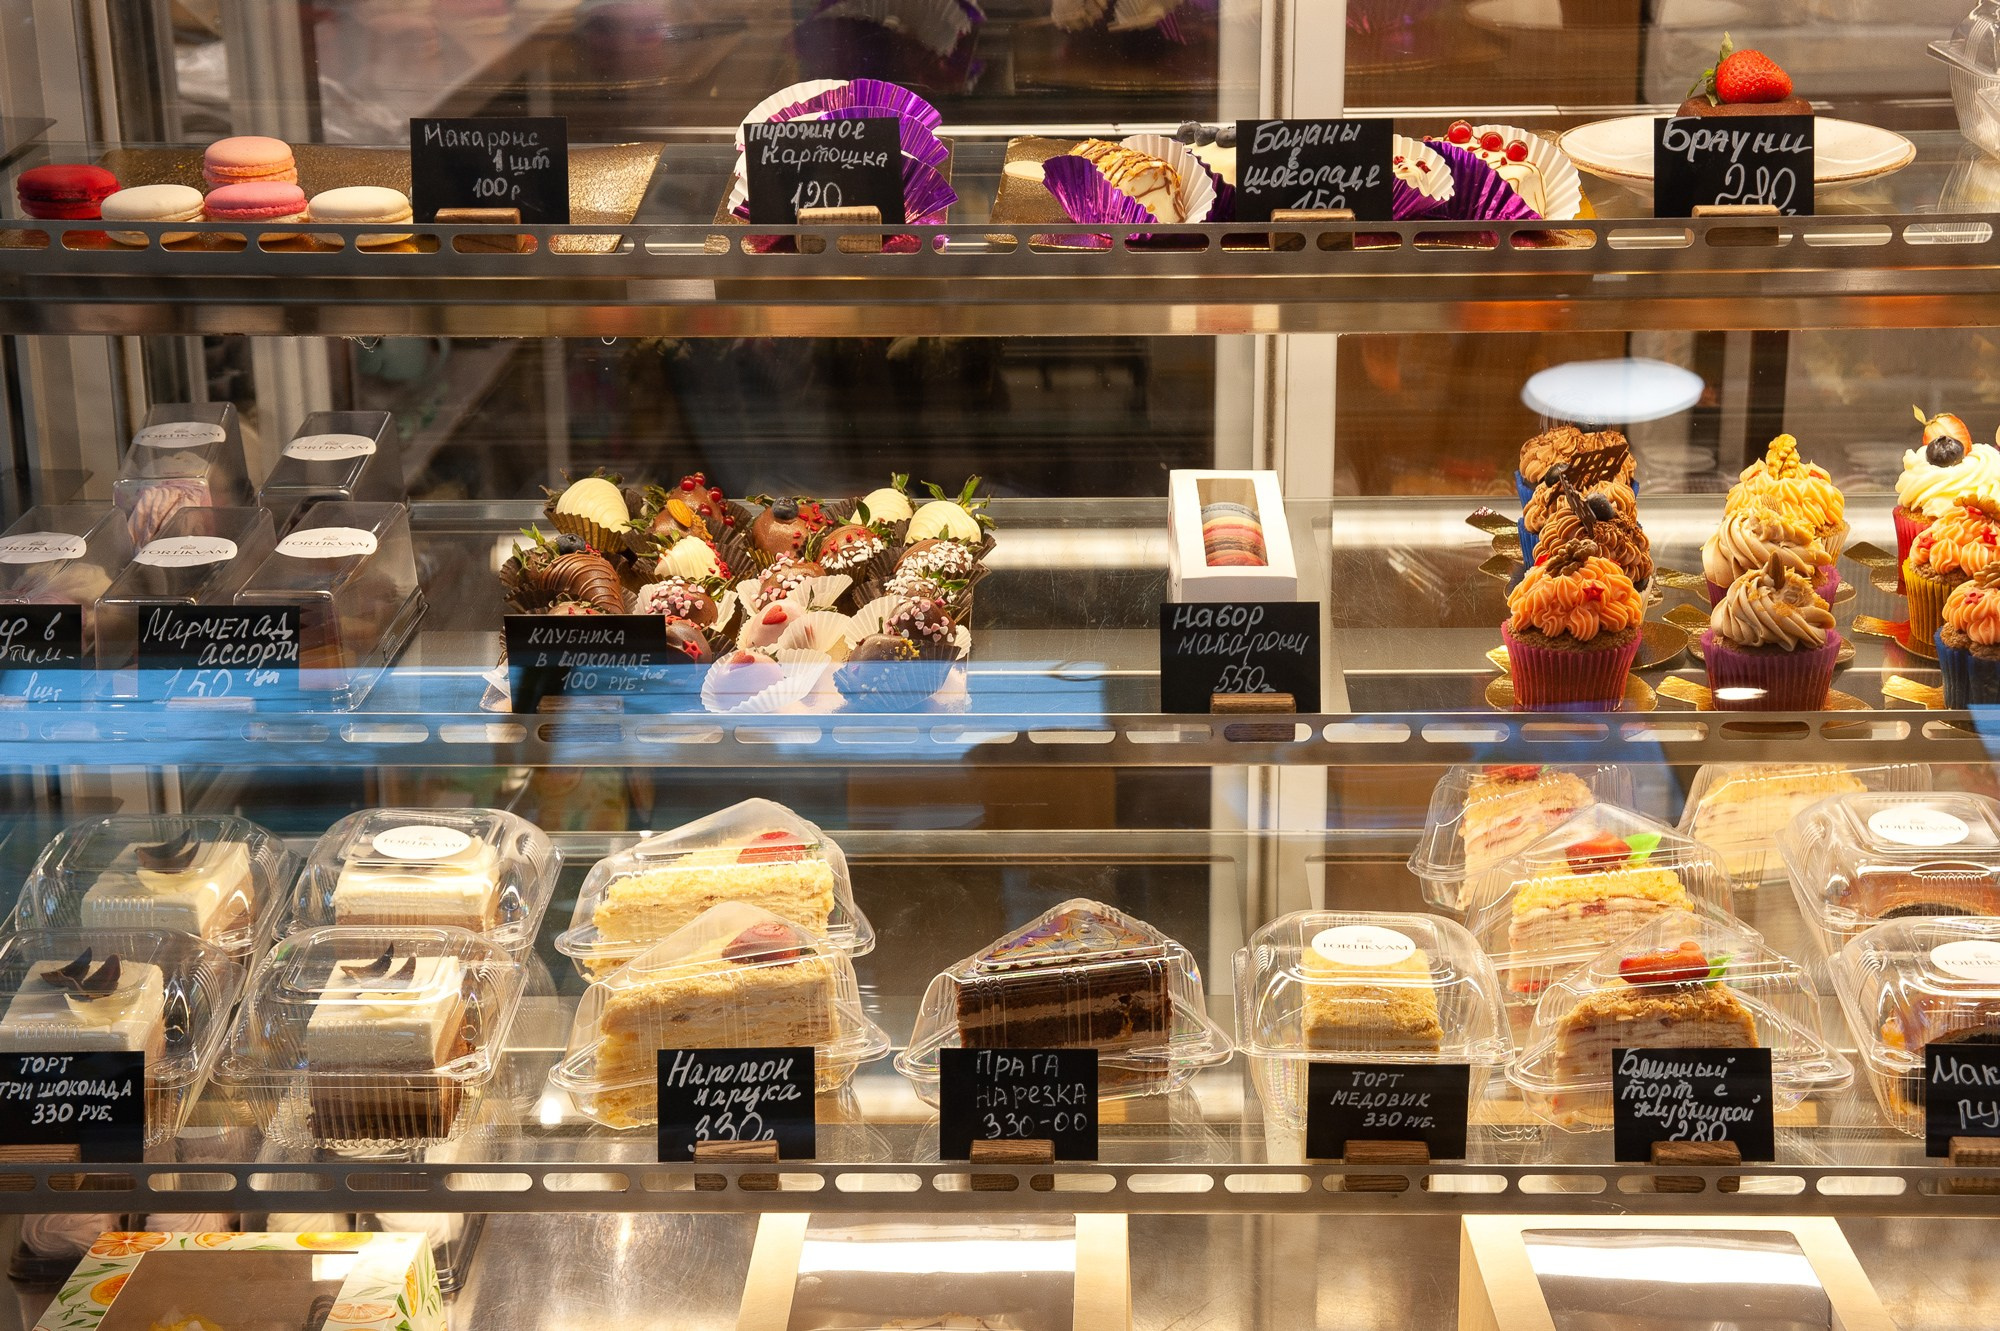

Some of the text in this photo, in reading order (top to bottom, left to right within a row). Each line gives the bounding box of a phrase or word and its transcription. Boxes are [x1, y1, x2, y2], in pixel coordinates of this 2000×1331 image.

[1252, 121, 1362, 154] Бананы
[1662, 116, 1813, 163] Брауни
[1288, 147, 1302, 170] в
[1243, 165, 1381, 194] шоколаде
[1173, 604, 1265, 636] Набор
[528, 627, 625, 645] КЛУБНИКА
[561, 671, 599, 690] 100
[20, 1056, 74, 1074] ТОРТ
[37, 1079, 132, 1101] ШОКОЛАДА
[1352, 1071, 1405, 1088] ТОРТ
[1330, 1090, 1431, 1109] МЕДОВИК
[31, 1103, 74, 1125] 330
[1362, 1112, 1403, 1128] 330
